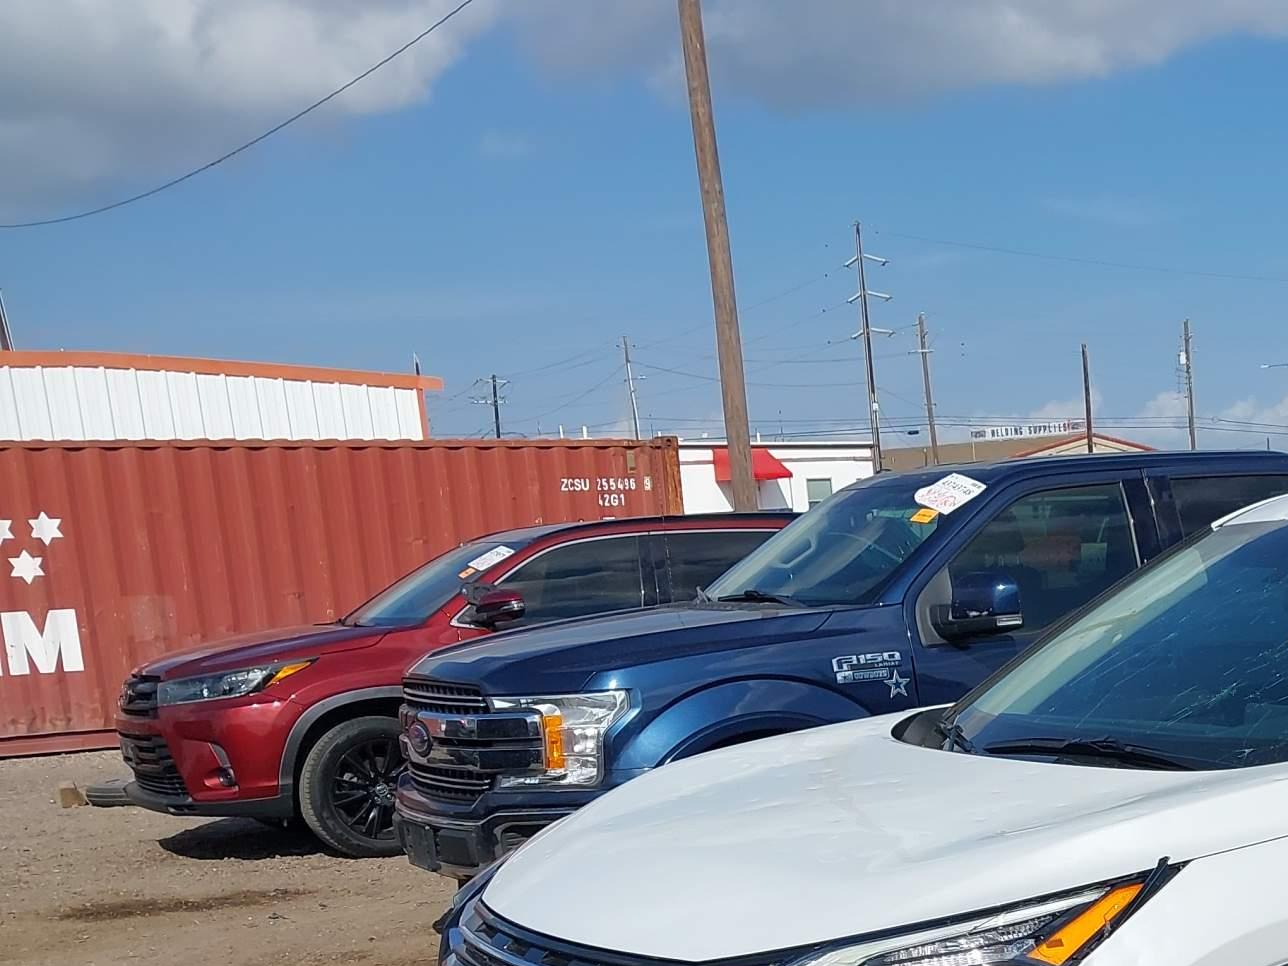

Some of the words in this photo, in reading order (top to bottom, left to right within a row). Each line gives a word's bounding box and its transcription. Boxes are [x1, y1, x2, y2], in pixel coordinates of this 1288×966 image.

[1028, 422, 1067, 435] SUPPLIES
[561, 478, 590, 491] ZCSU
[0, 608, 85, 677] M
[832, 651, 902, 672] F150
